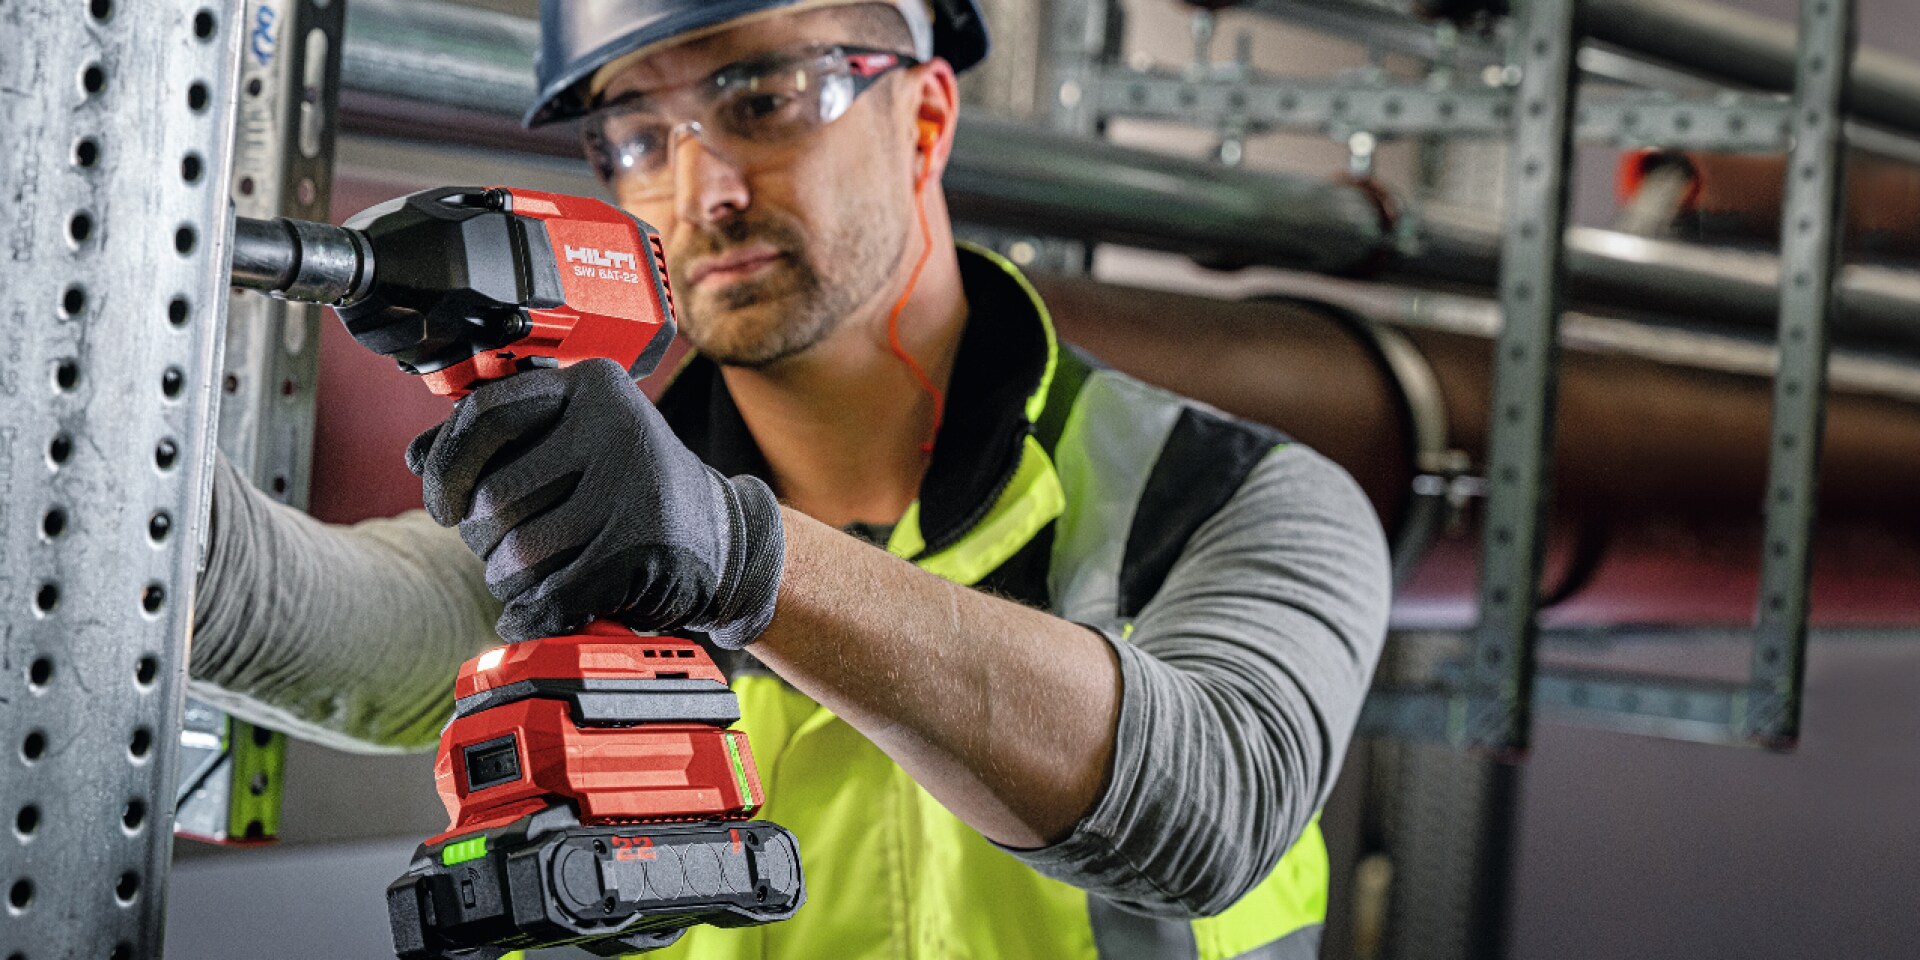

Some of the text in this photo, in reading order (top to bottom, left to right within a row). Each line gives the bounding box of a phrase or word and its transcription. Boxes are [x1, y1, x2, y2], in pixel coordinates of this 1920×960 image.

[564, 244, 636, 270] HILTI
[573, 265, 638, 283] SIW 6AT-22
[611, 835, 656, 861] 22
